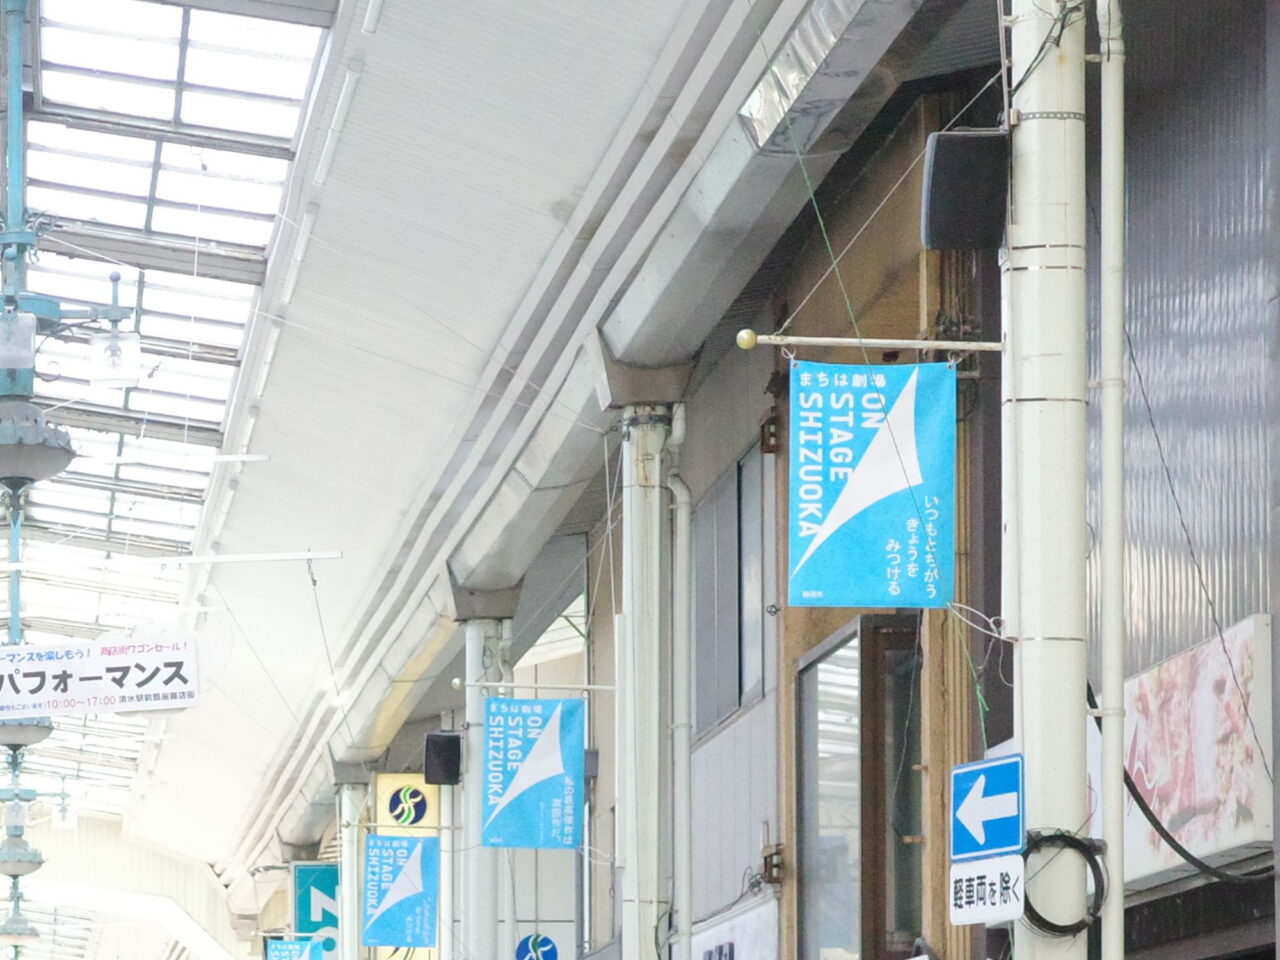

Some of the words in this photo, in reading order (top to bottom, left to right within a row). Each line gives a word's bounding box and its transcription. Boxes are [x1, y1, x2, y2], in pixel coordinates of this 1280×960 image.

[800, 372, 887, 388] まちは劇場
[830, 392, 854, 482] STAGE
[862, 393, 886, 428] ON
[799, 392, 823, 537] SHIZUOKA
[886, 539, 901, 596] みつける
[906, 517, 920, 578] きょうを
[924, 495, 939, 599] いつもとちがう
[507, 716, 523, 772] STAGE
[527, 717, 543, 739] ON
[488, 715, 504, 806] SHIZUOKA
[367, 848, 380, 916] SHIZUOKA
[382, 848, 394, 890] STAGE
[396, 848, 408, 866] ON
[952, 870, 1021, 910] 軽車両を除く
